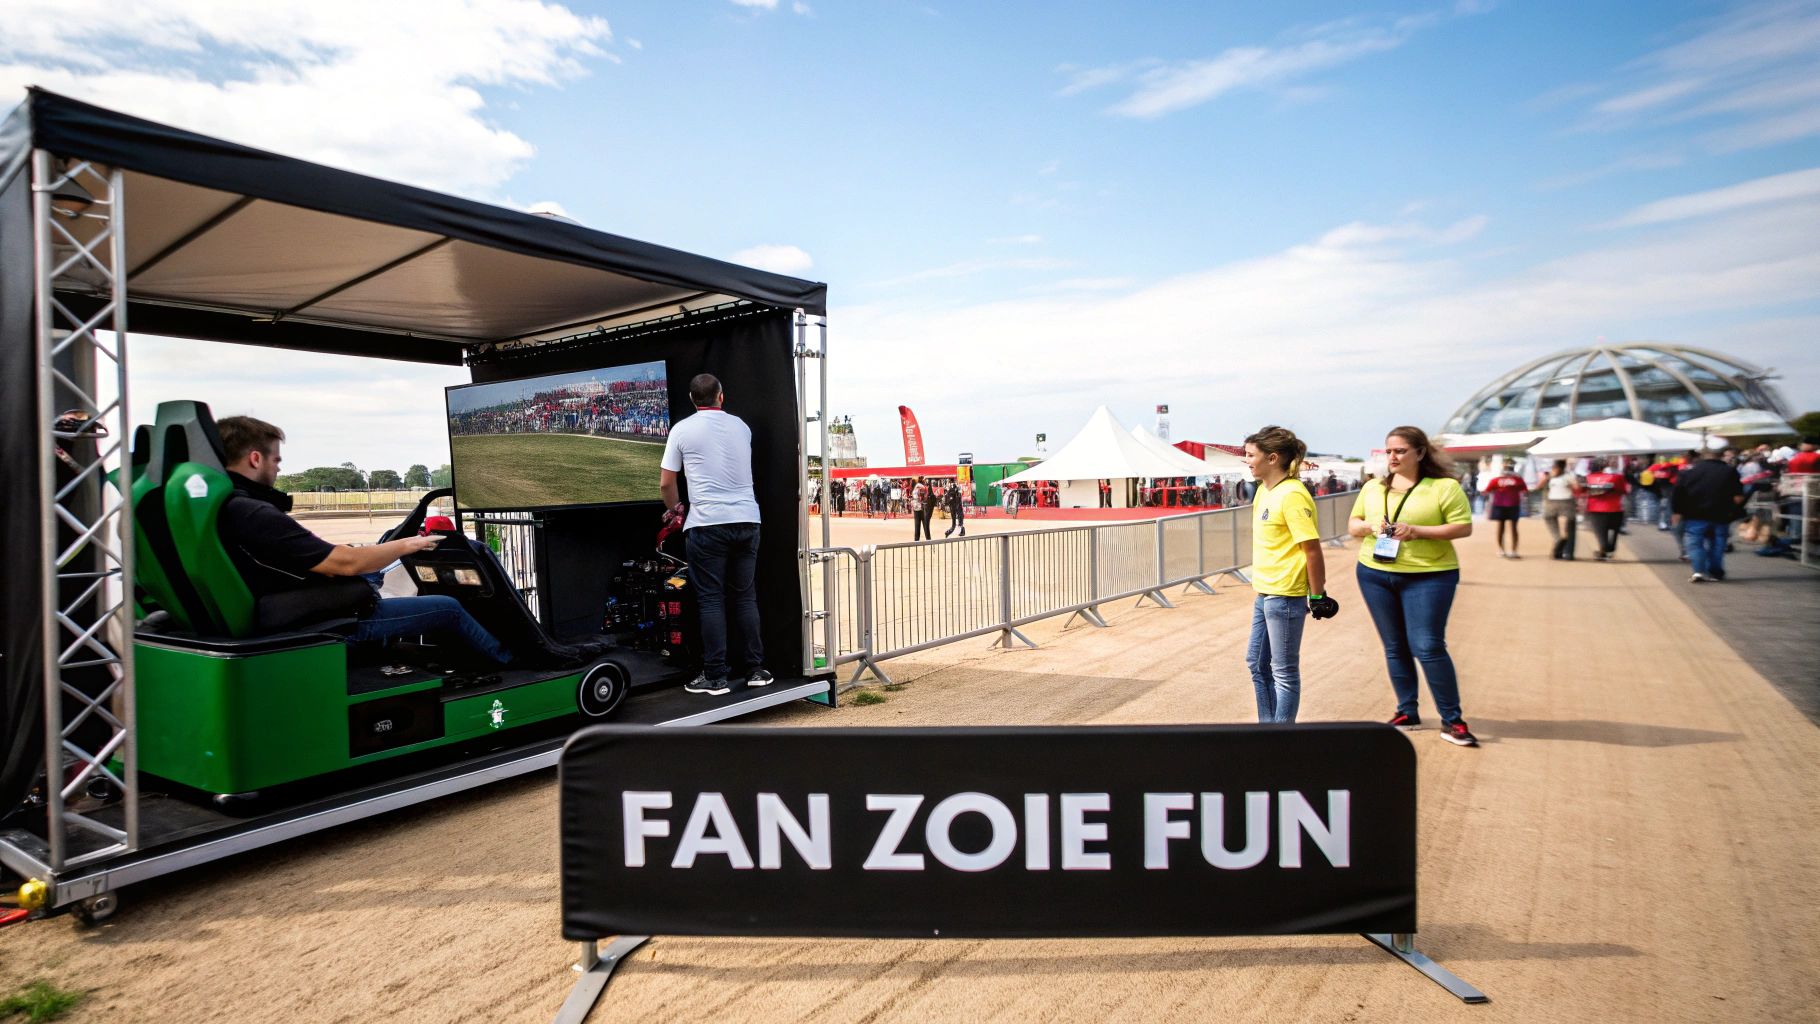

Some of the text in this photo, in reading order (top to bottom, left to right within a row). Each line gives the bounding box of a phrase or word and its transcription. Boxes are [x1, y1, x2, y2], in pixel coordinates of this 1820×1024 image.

[622, 789, 1351, 871] FAN ZOIE FUN
